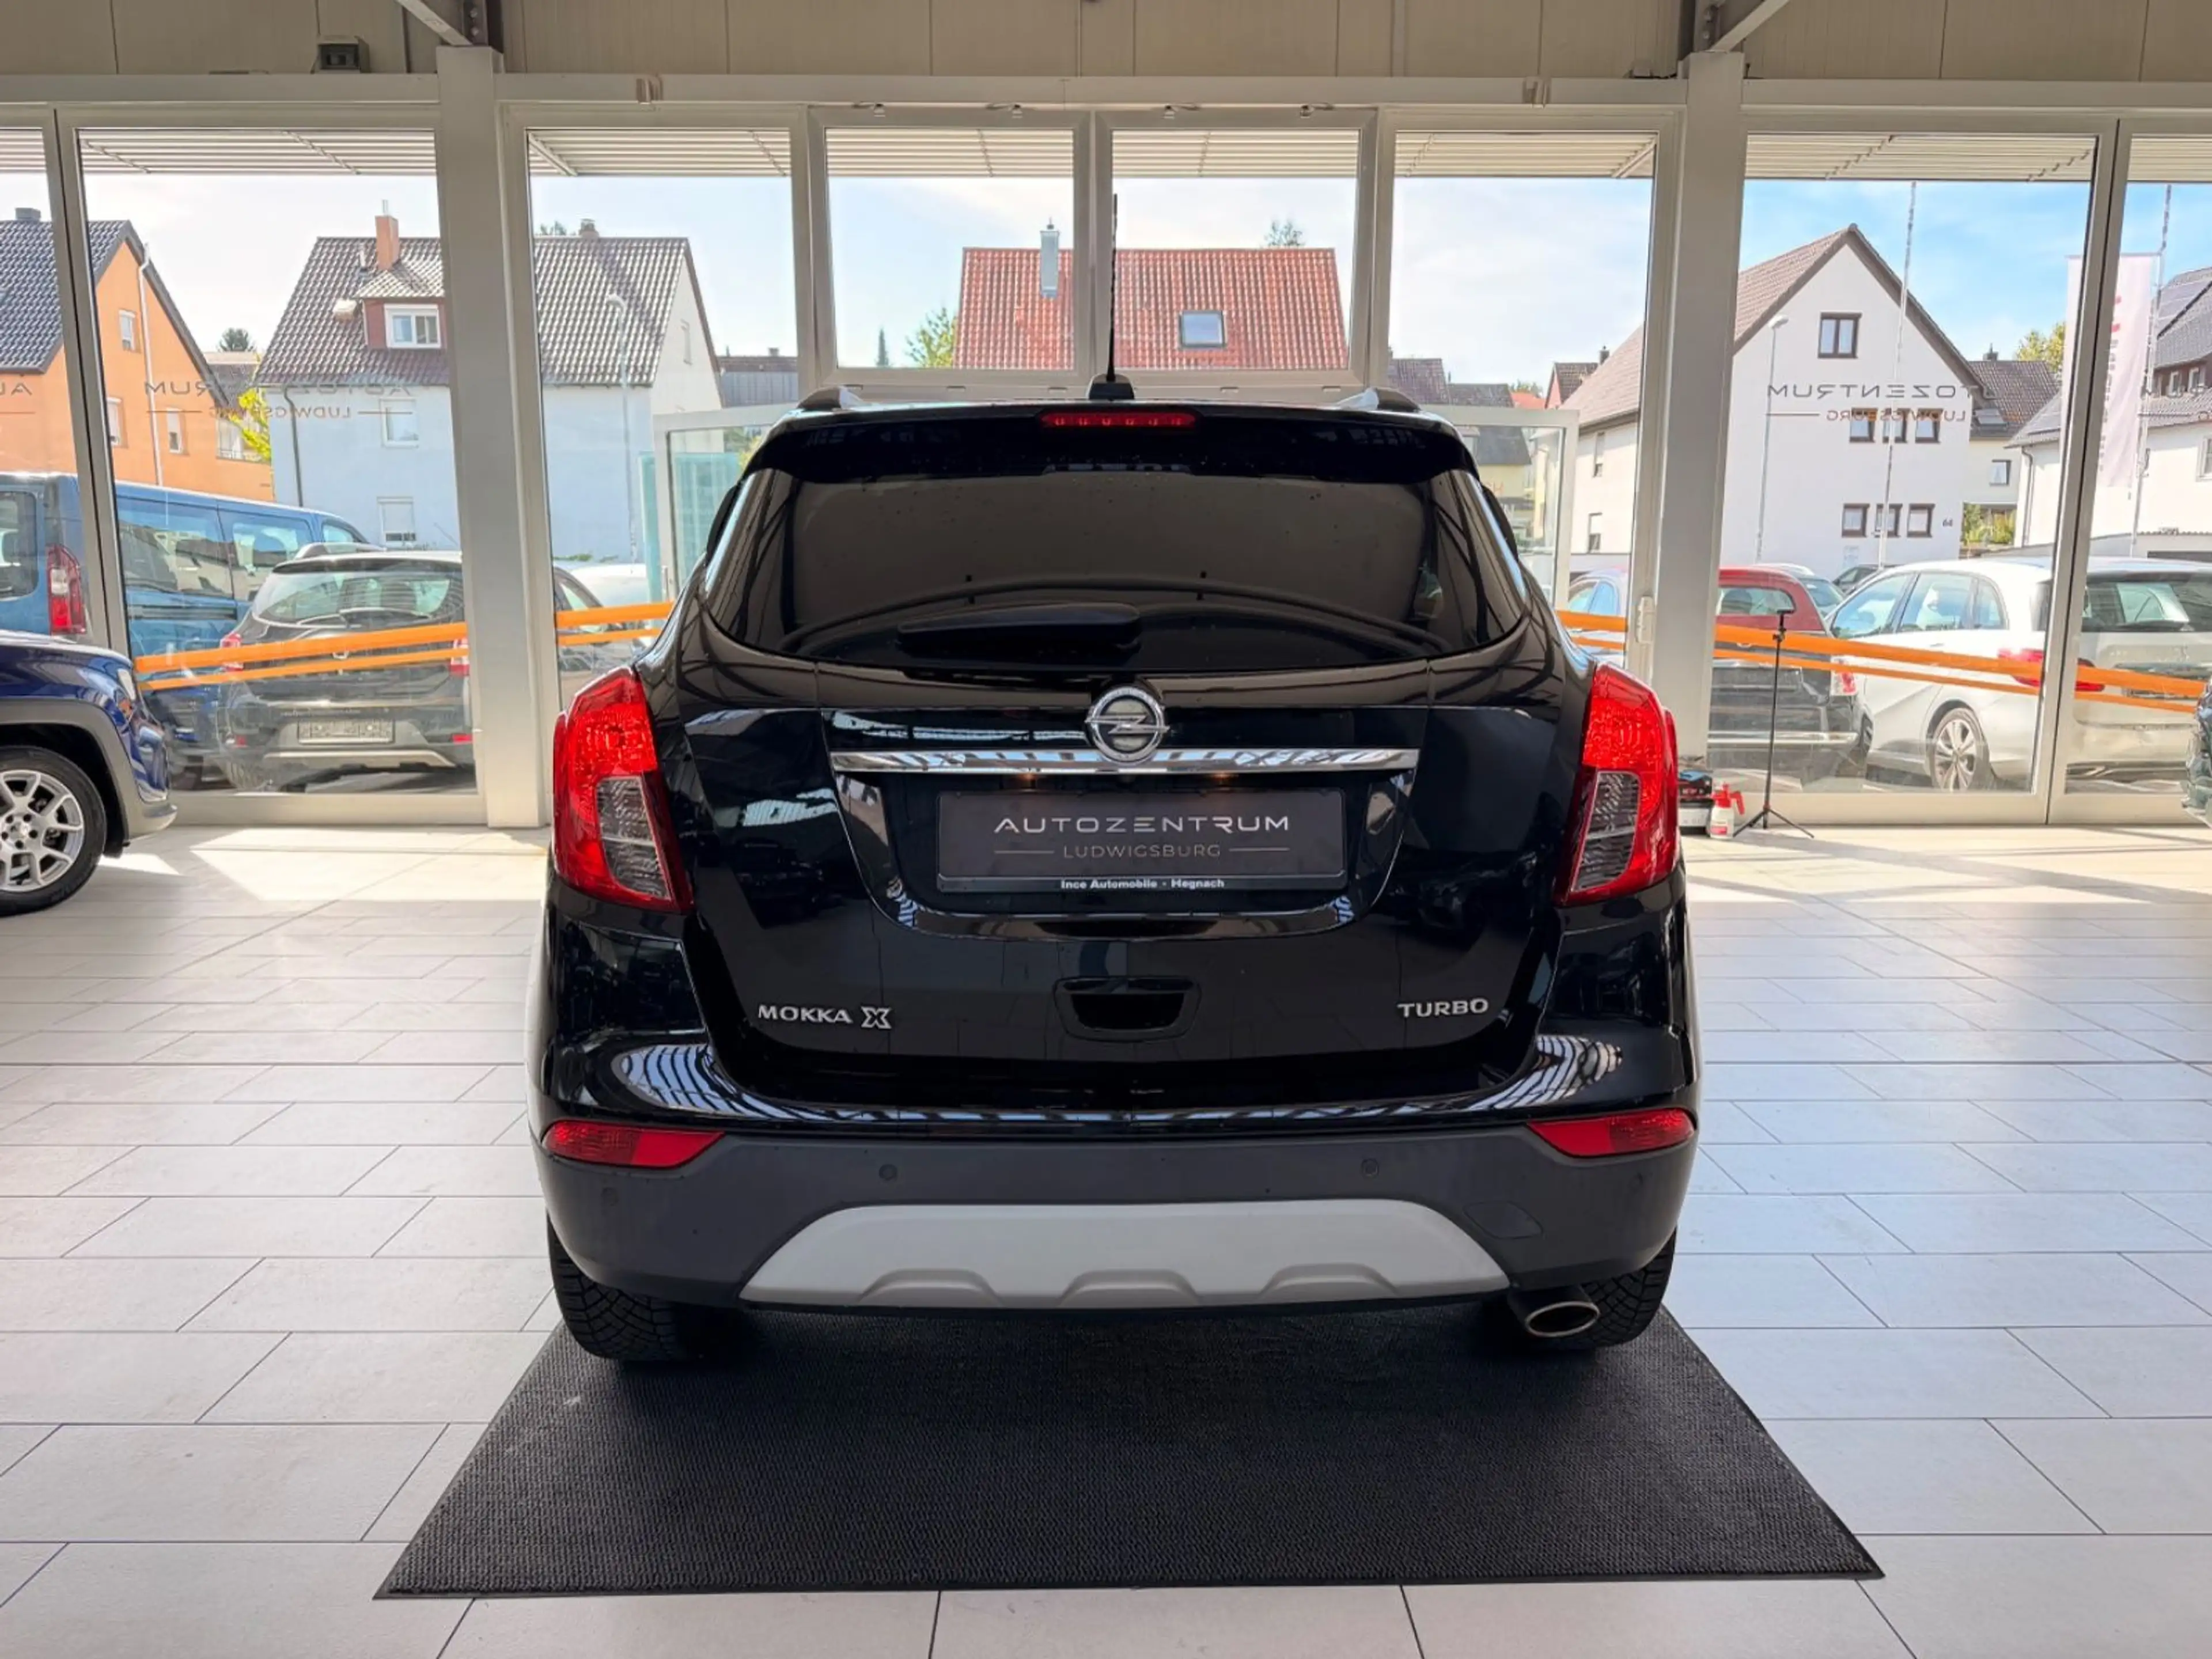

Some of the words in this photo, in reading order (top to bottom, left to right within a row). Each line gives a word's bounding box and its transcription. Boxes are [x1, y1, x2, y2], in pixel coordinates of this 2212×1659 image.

[994, 816, 1289, 834] AUTOZENTRUM
[1064, 844, 1221, 859] LUDWIGSBURG
[1061, 880, 1087, 889] Ince
[1090, 878, 1158, 889] Automobile
[1171, 878, 1225, 891] Hegnach
[758, 1004, 854, 1024] MOKKA
[861, 1006, 892, 1029] X
[1397, 997, 1488, 1018] TURBO
